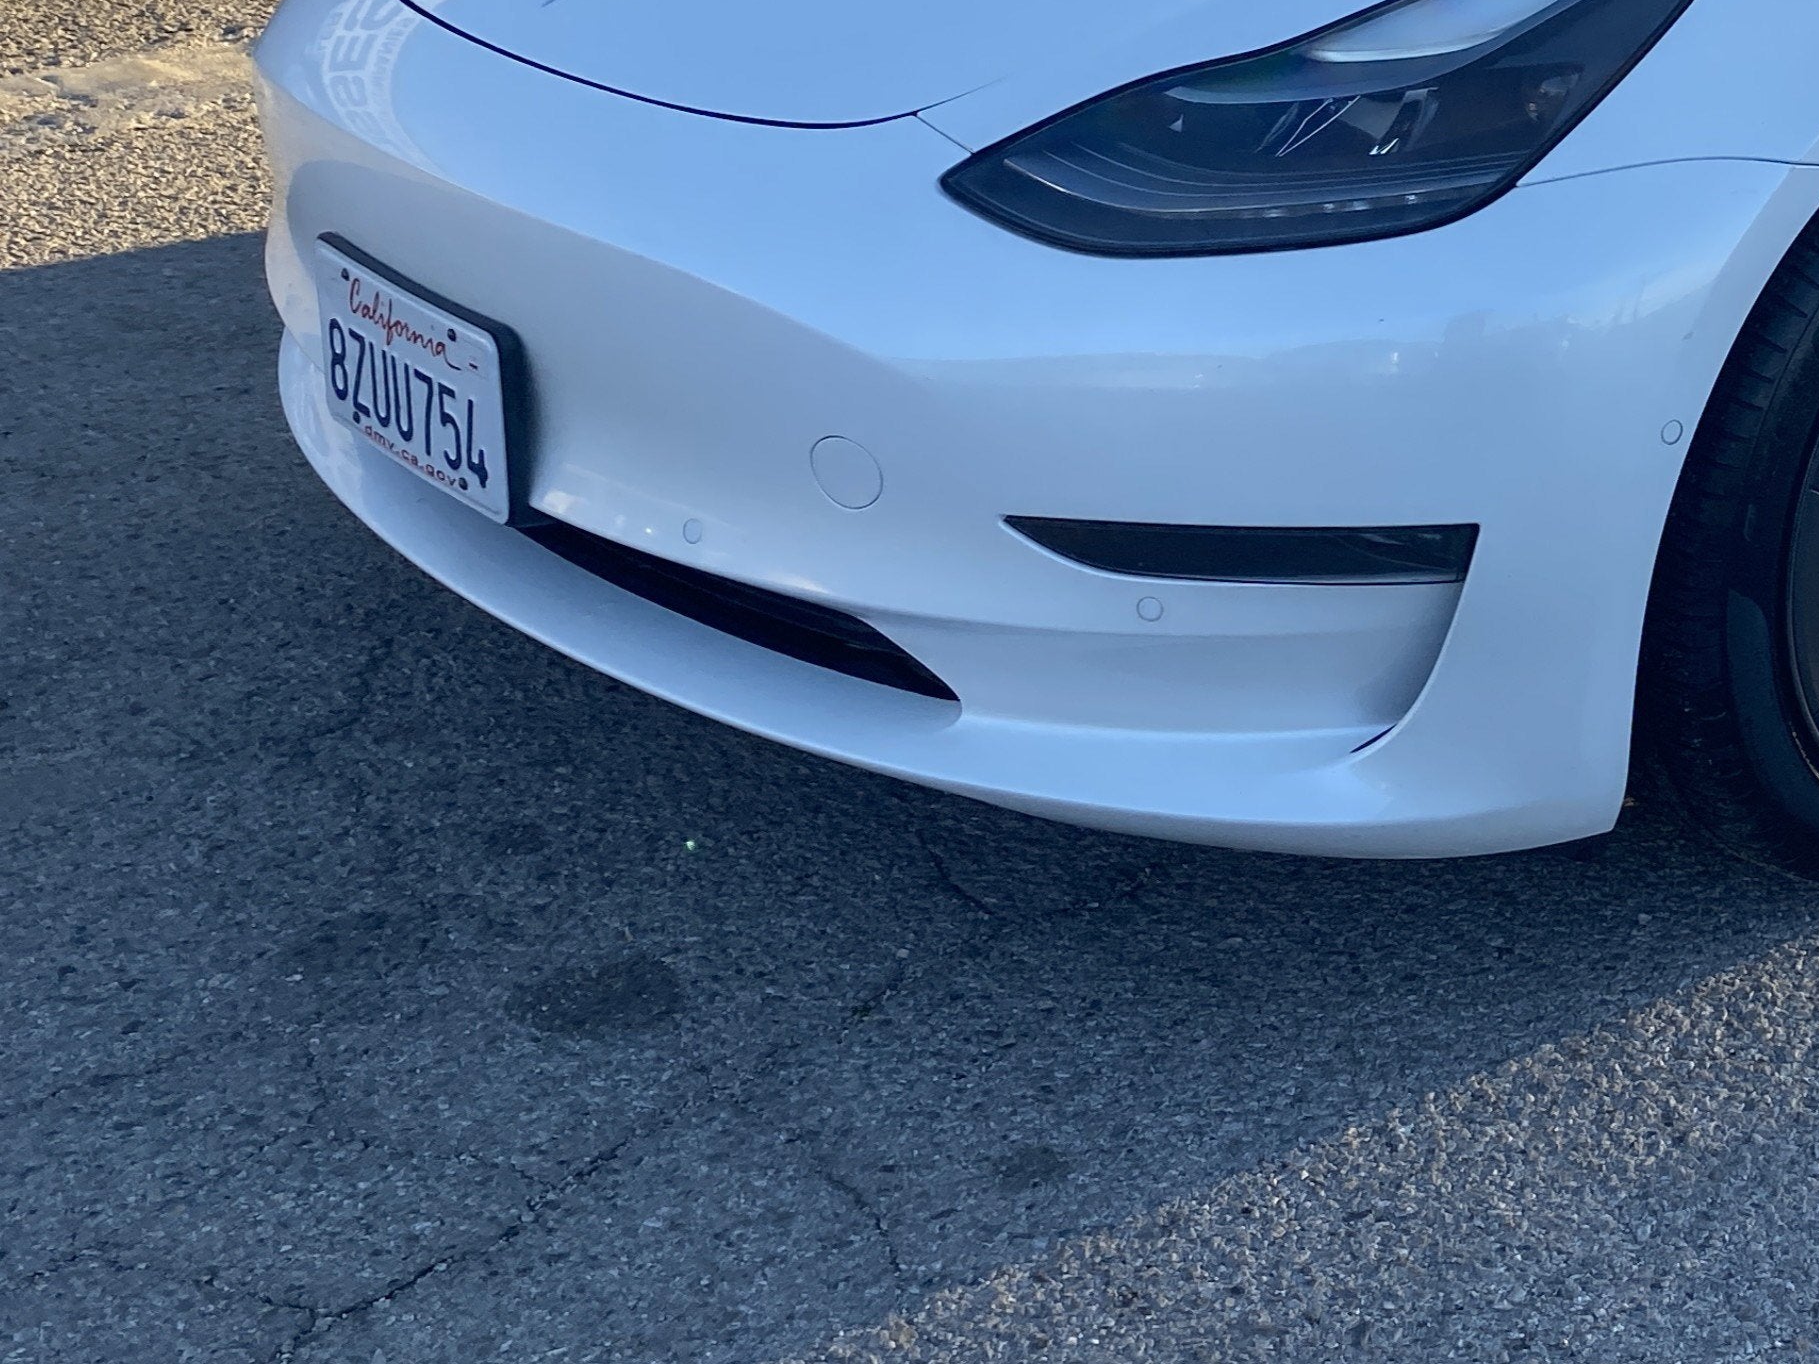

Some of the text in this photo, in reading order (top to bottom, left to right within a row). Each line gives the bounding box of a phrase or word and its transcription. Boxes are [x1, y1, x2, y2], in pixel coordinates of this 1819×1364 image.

[349, 277, 462, 371] California
[328, 317, 489, 489] 8ZUU754
[363, 423, 460, 486] dmv.ca.gov
